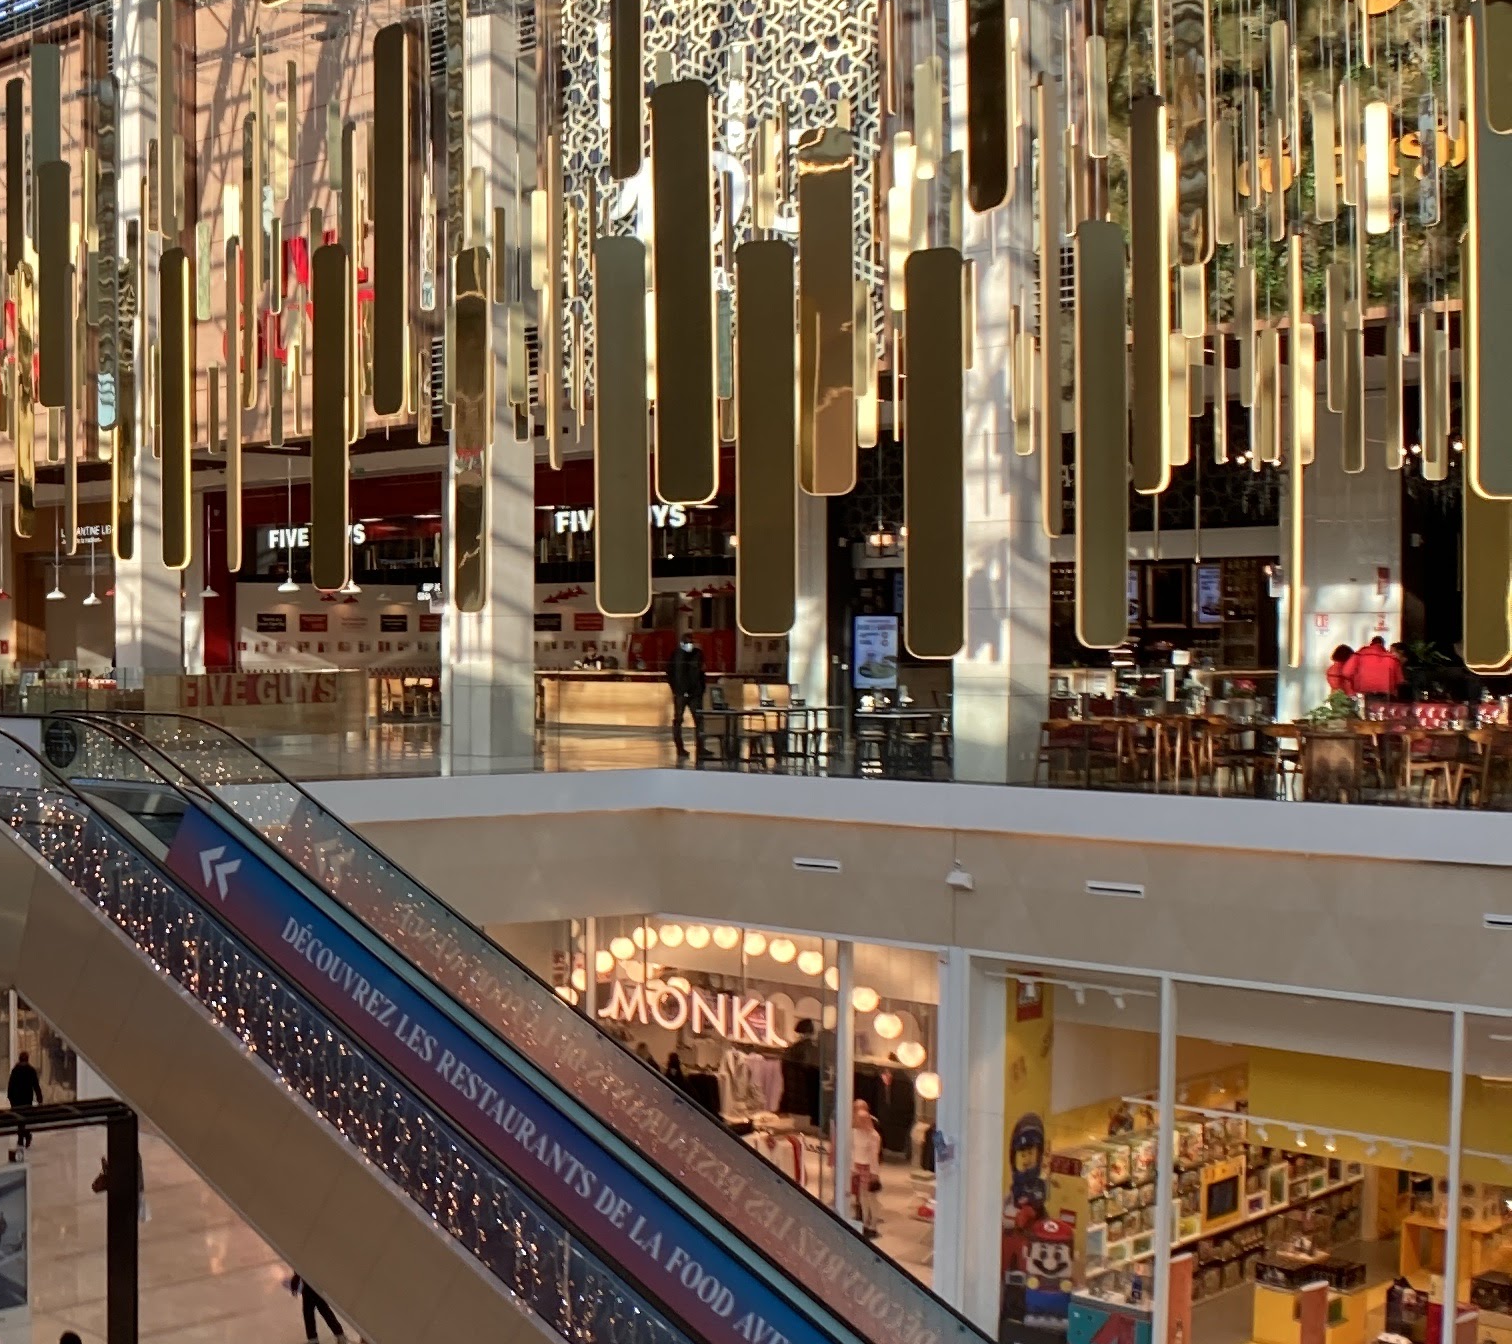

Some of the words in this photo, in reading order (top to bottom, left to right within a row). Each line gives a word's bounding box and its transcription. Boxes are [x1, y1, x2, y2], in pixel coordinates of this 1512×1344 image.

[555, 509, 595, 533] FIV
[269, 527, 310, 549] FIVE
[181, 674, 248, 706] FIVE
[256, 674, 337, 705] GUYS
[597, 979, 789, 1048] MONKI
[281, 915, 398, 1028] DÉCOUVREZ
[394, 1014, 438, 1062] LES
[435, 1049, 598, 1200] RESTAURANTS
[593, 1184, 633, 1229] DE
[628, 1215, 663, 1261] LA
[664, 1246, 736, 1319] FOOD
